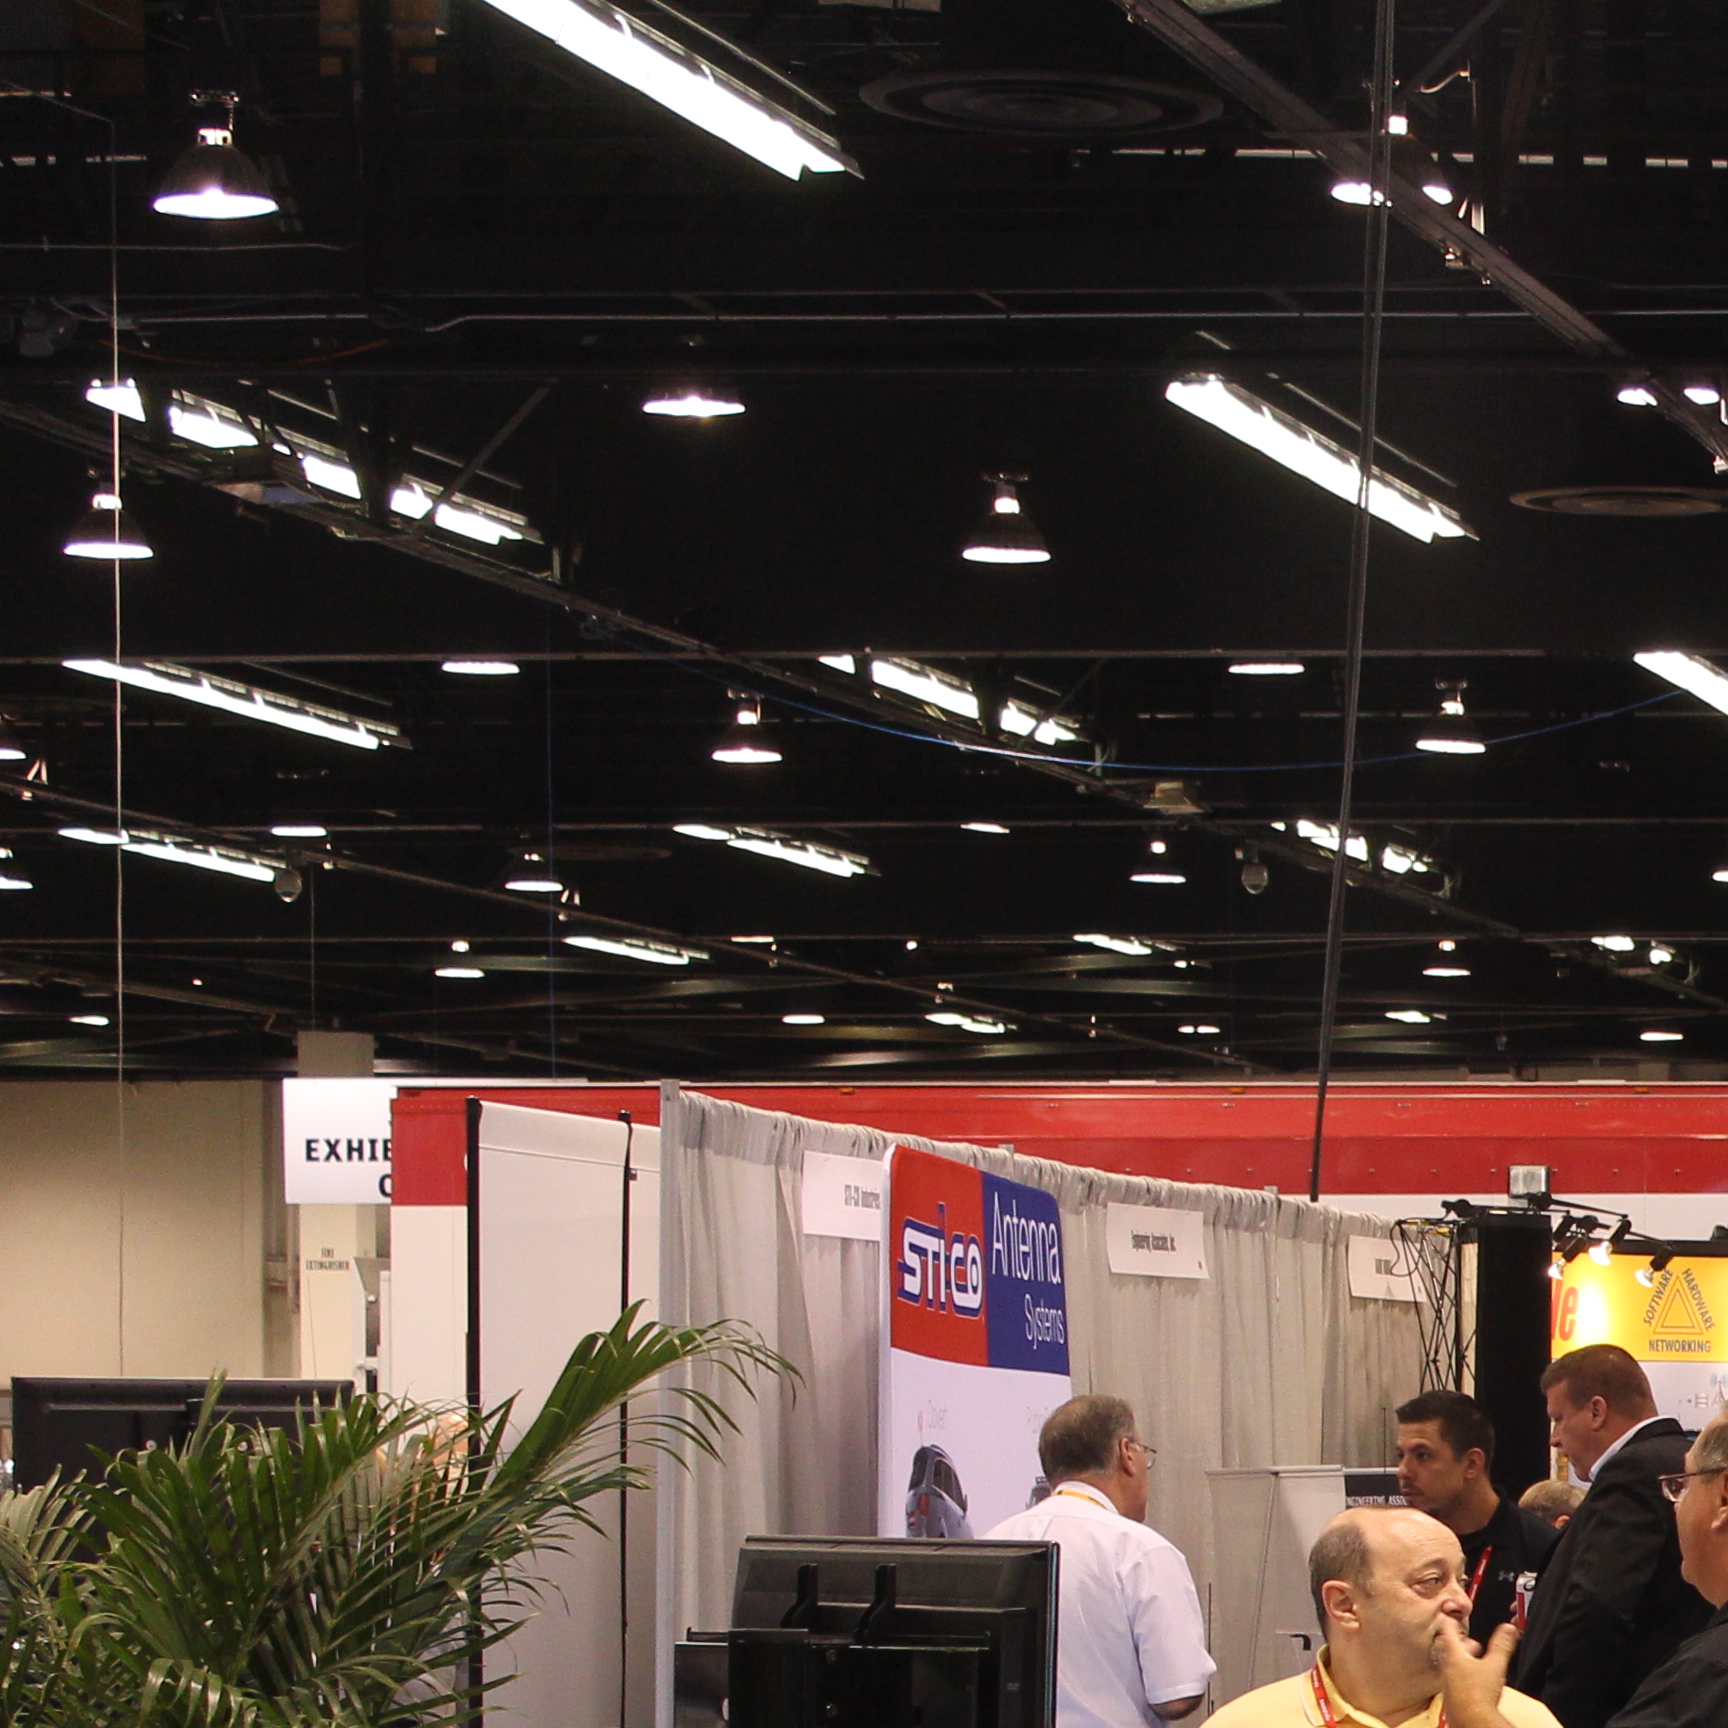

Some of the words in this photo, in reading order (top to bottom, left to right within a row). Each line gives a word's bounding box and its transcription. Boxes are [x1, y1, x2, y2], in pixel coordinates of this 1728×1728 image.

[991, 1191, 1062, 1285] Antenna
[1024, 1294, 1065, 1350] Systems
[1643, 1267, 1674, 1326] SOFTWARE
[1681, 1267, 1716, 1332] HARDWARE
[1648, 1339, 1712, 1353] NETWORKING
